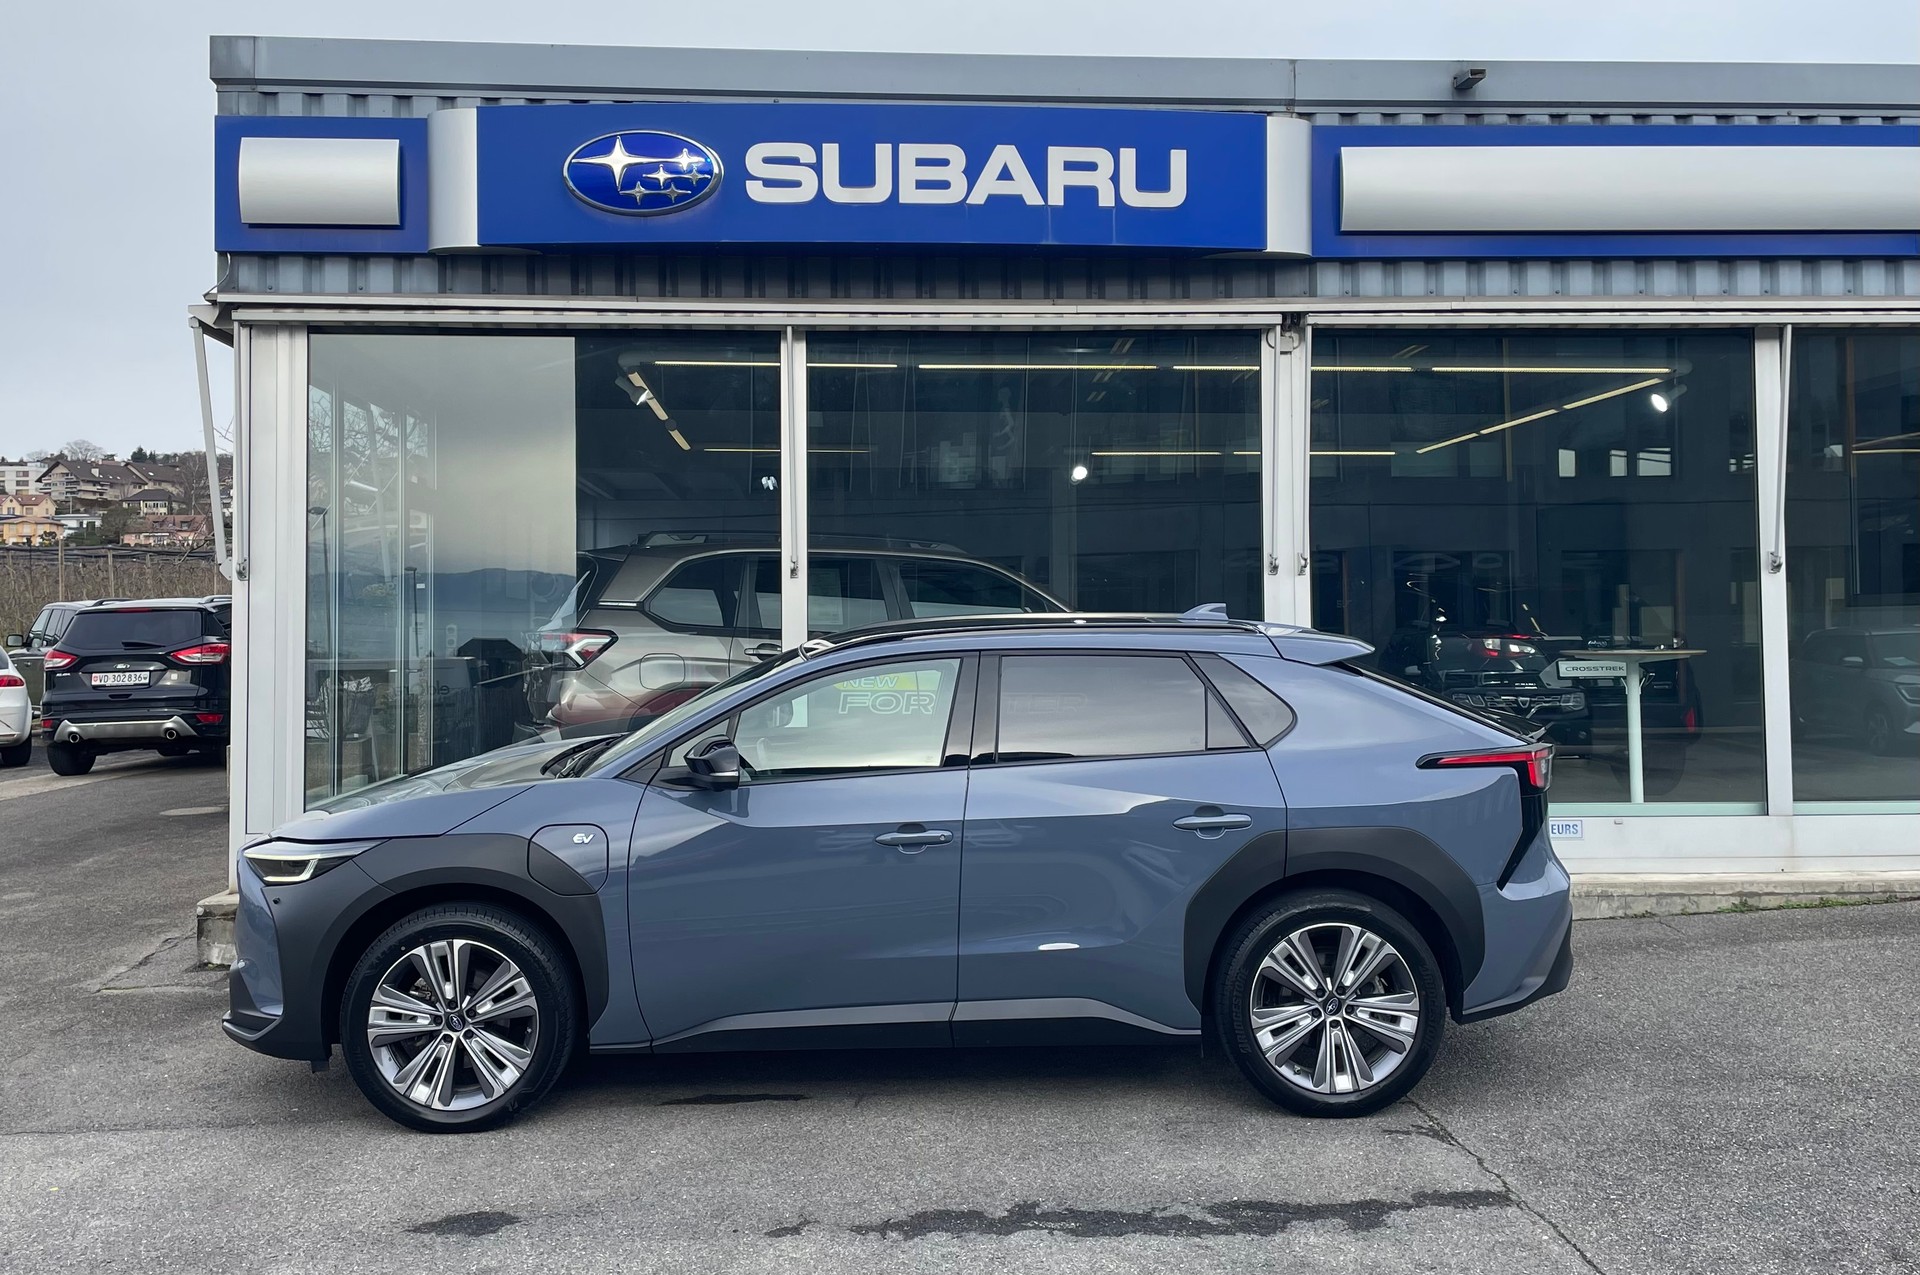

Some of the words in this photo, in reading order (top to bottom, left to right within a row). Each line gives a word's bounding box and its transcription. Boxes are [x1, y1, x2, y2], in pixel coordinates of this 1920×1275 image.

[745, 142, 1187, 207] SUBARU
[99, 674, 109, 683] VD
[843, 676, 899, 688] NEW
[572, 833, 595, 844] EV
